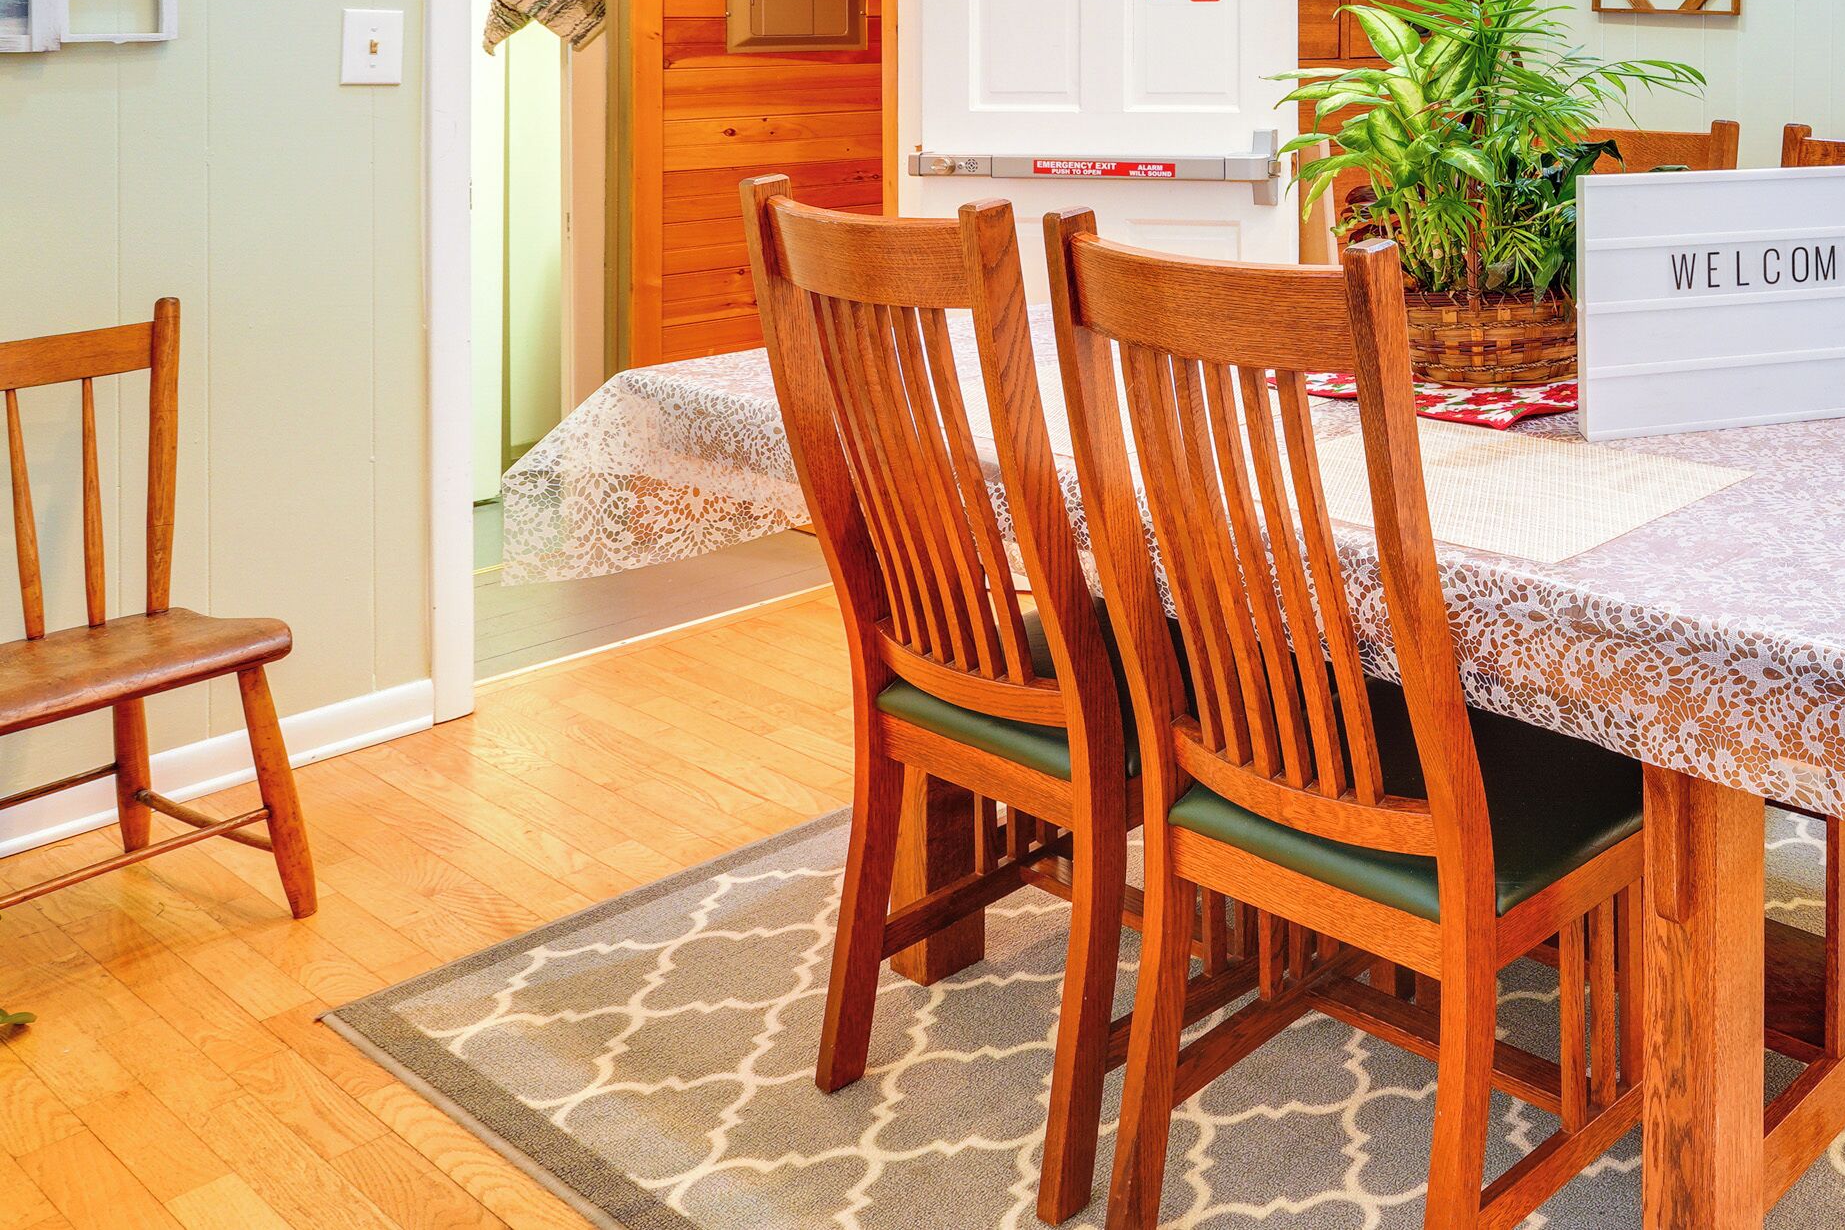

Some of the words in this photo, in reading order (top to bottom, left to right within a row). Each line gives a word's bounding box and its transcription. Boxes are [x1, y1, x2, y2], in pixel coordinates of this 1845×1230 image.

[1036, 161, 1093, 170] EMERGENCY
[1095, 162, 1117, 170] EXIT
[1671, 245, 1836, 291] WELCOM
